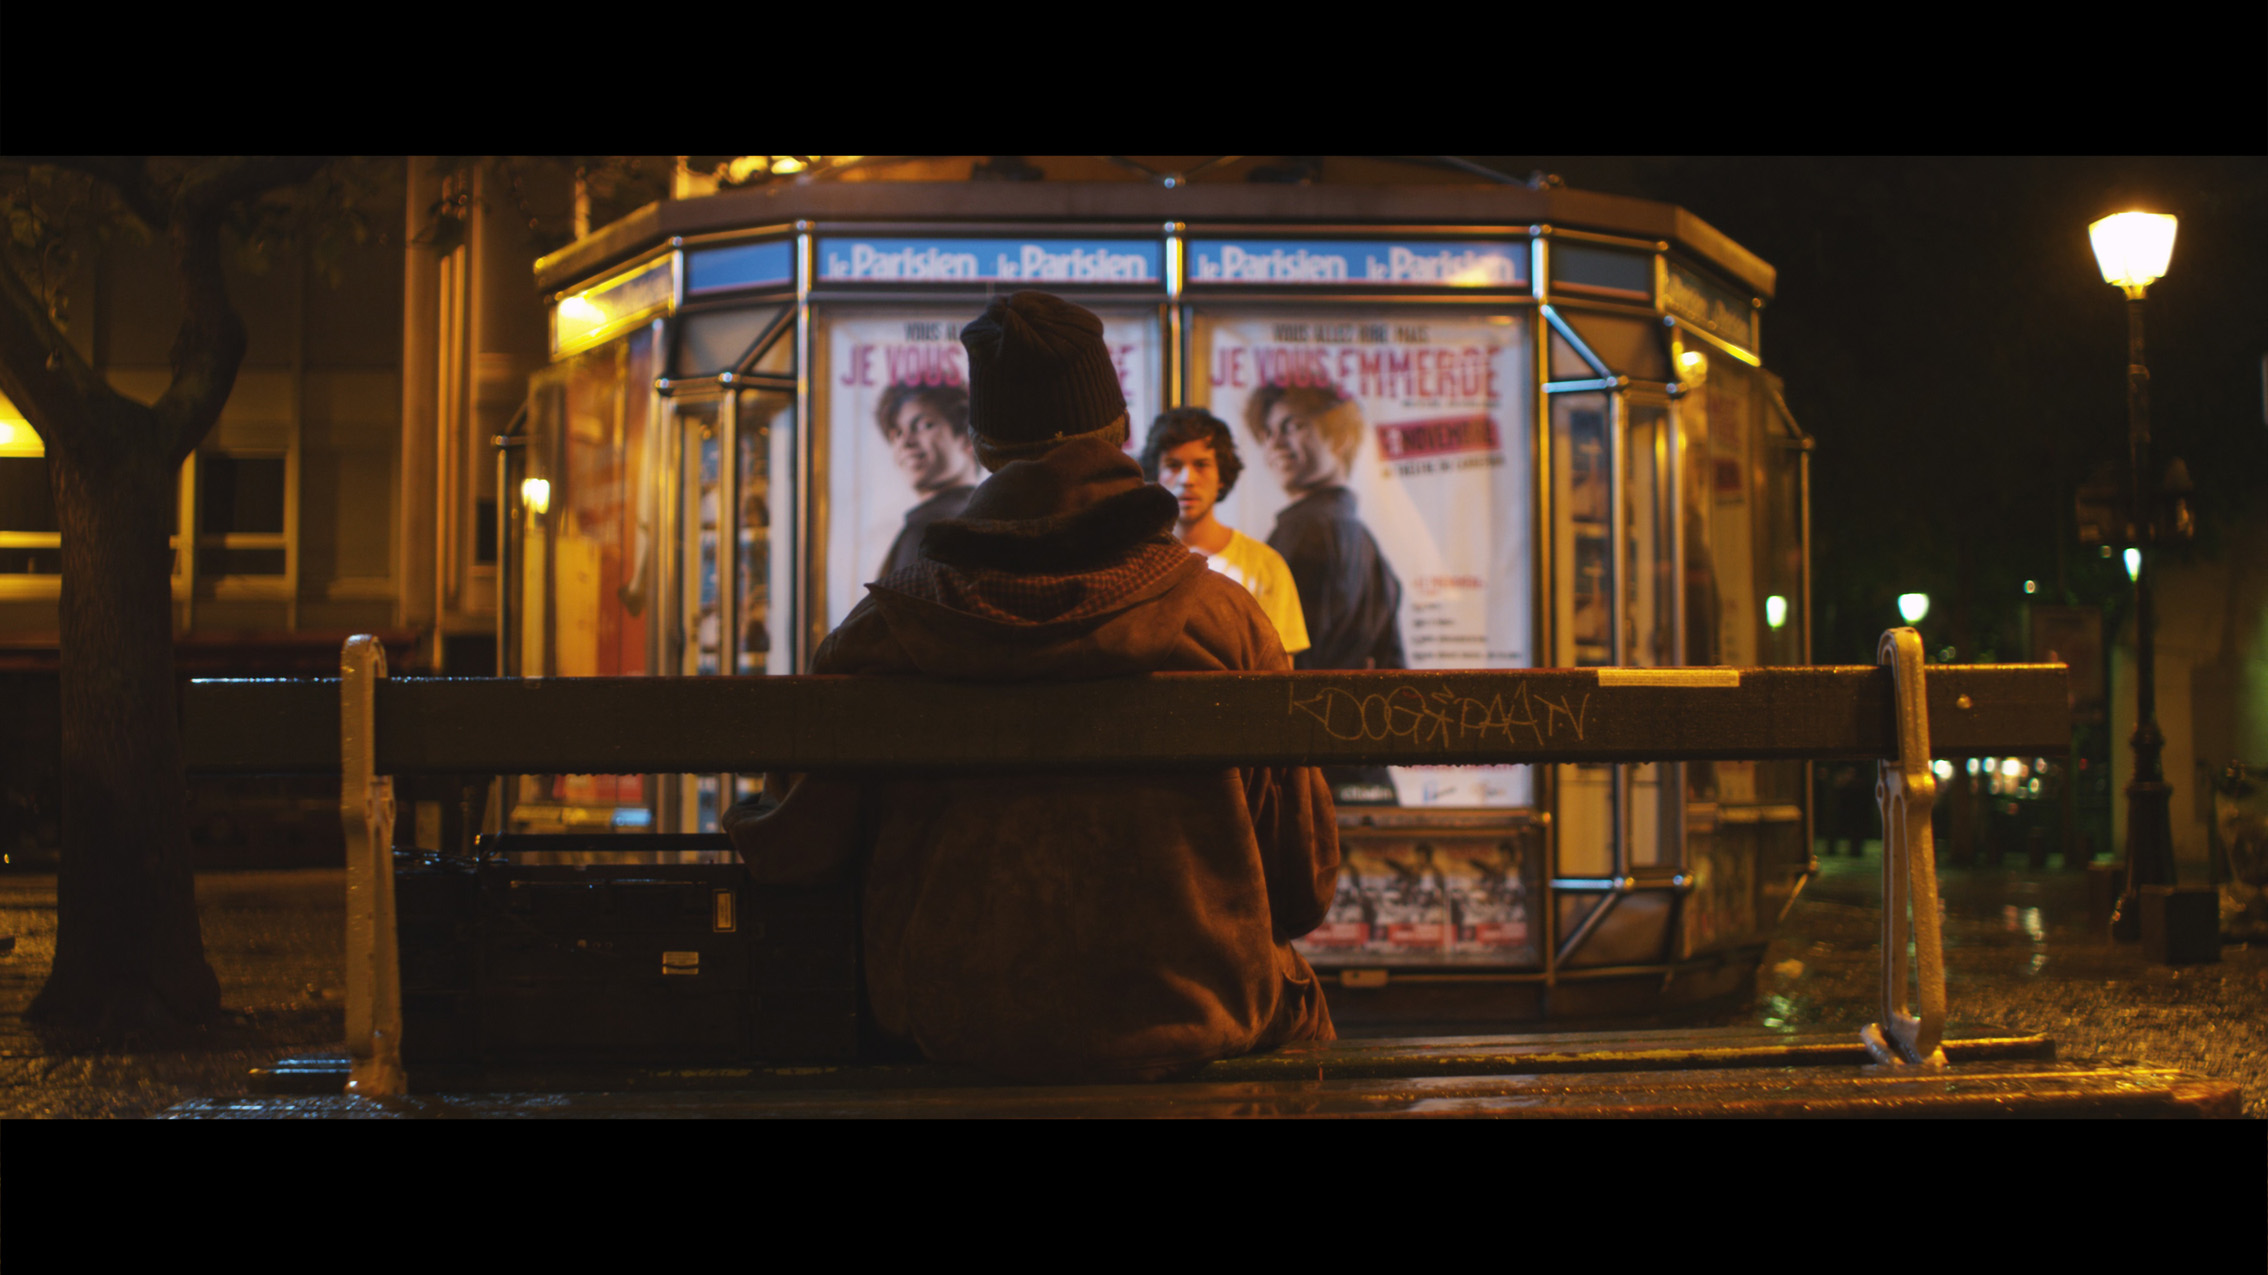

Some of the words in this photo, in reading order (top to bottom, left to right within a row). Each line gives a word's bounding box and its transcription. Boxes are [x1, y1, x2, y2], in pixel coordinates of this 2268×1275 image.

[828, 251, 849, 279] le
[851, 243, 978, 279] Parisien
[998, 252, 1019, 279] le
[1020, 244, 1148, 279] Parisien
[1199, 252, 1219, 280] le
[1221, 245, 1347, 280] Parisien
[1366, 254, 1388, 281] le
[840, 344, 875, 387] JE
[885, 344, 961, 388] VOUS
[1209, 346, 1246, 388] JE
[1252, 346, 1332, 389] VOUS
[1336, 346, 1503, 400] EMMERDE
